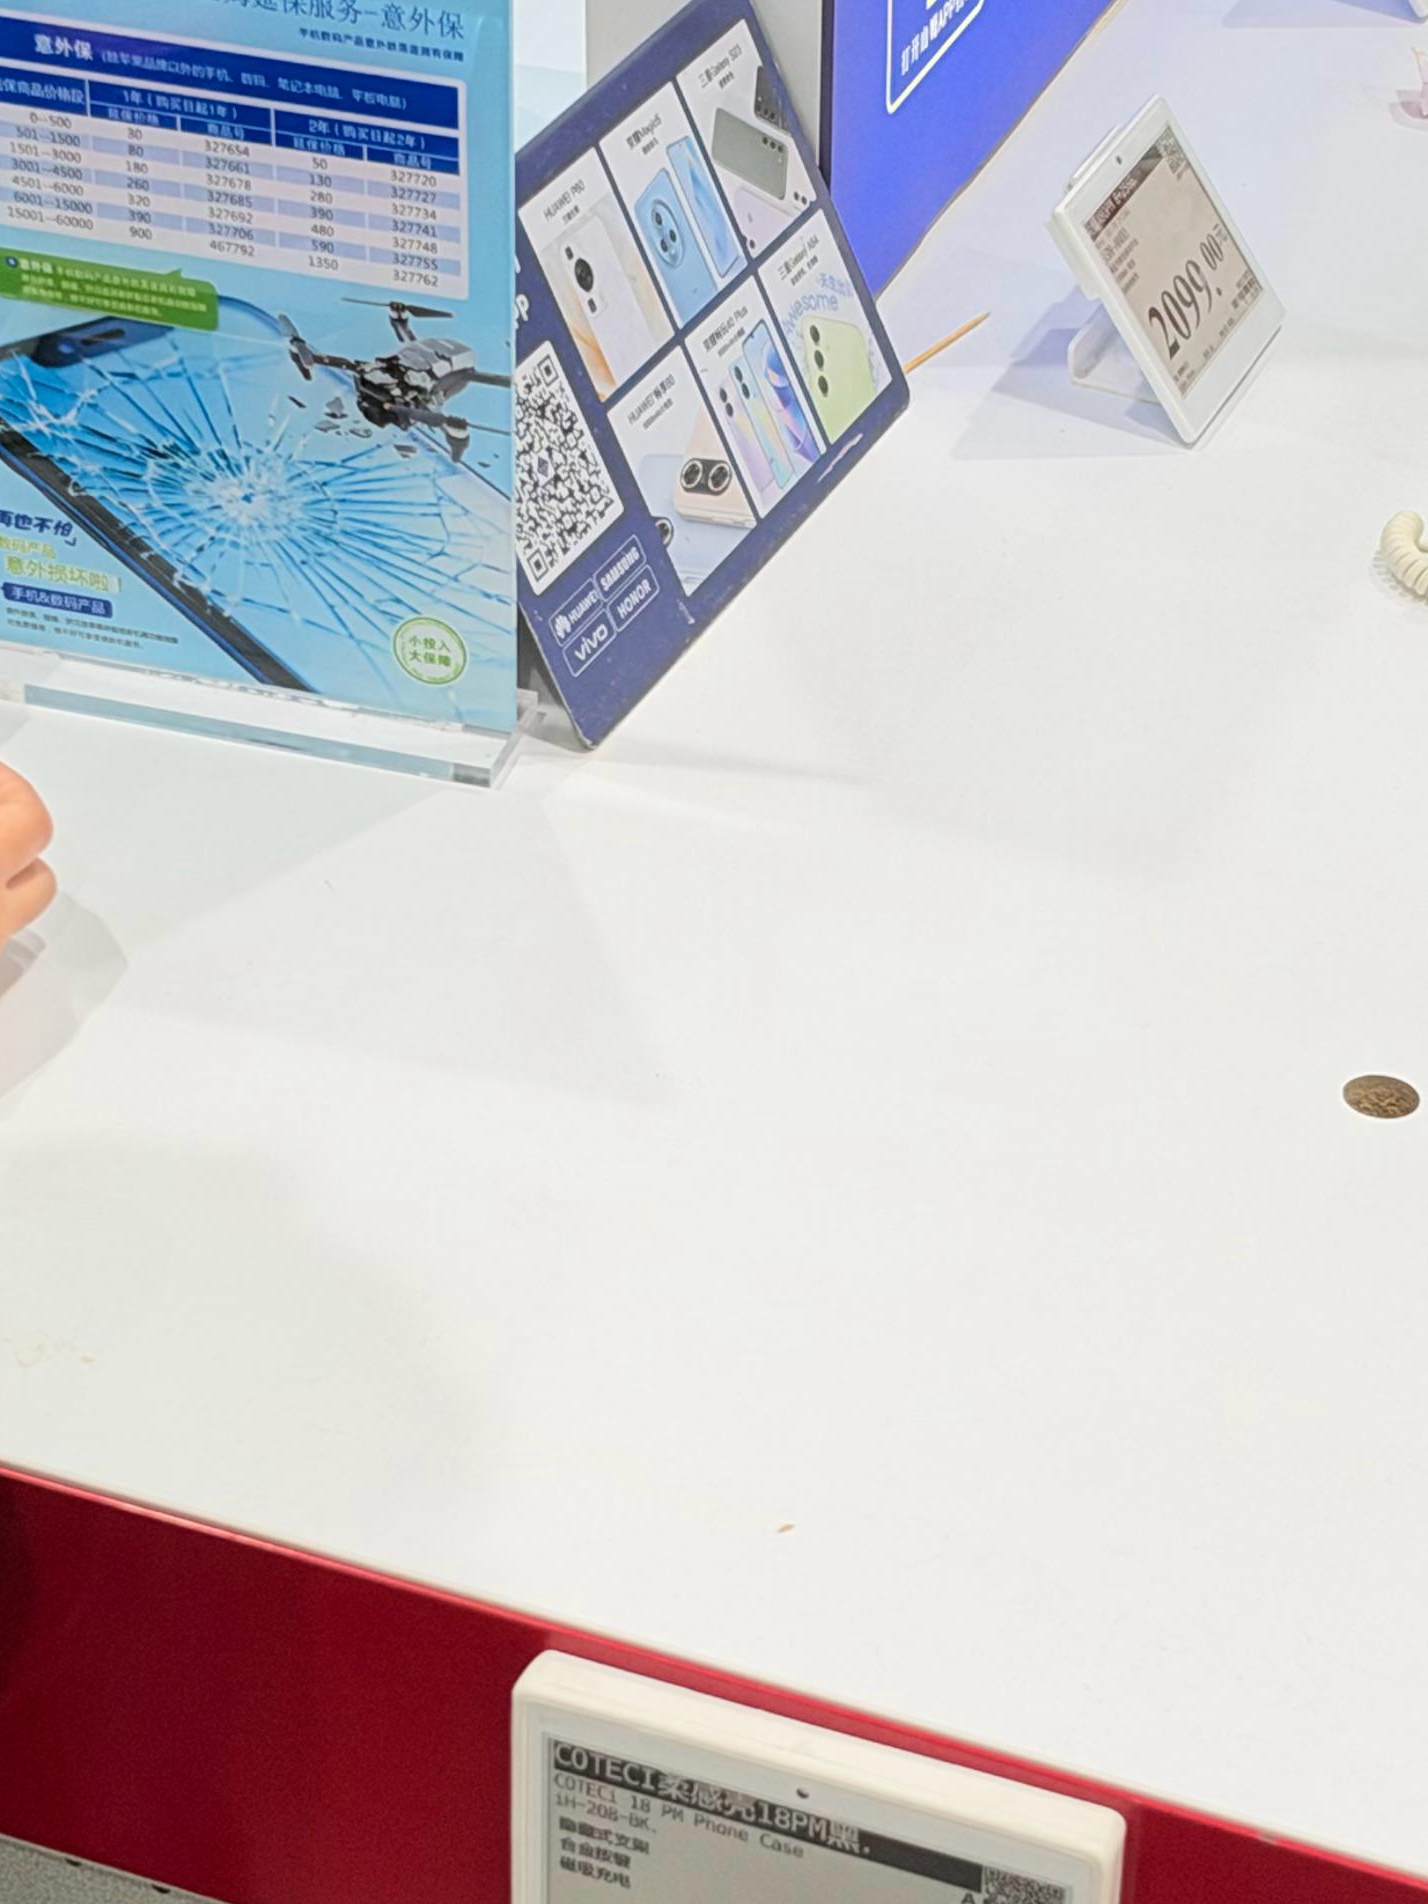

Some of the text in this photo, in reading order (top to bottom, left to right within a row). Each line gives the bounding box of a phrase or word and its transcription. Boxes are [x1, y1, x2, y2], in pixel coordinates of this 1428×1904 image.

[34, 33, 94, 62] 意外保
[127, 127, 143, 141] 30
[204, 139, 251, 159] 327654
[312, 157, 328, 171] 50
[390, 169, 437, 188] 327720
[128, 145, 144, 159] 80
[205, 156, 251, 175] 327661
[309, 173, 332, 188] 130
[390, 186, 437, 205] 327727
[125, 161, 148, 175] 180
[206, 173, 252, 192] 327678
[310, 190, 333, 205] 280
[391, 203, 437, 221] 327734
[126, 177, 150, 192] 260
[207, 190, 253, 209] 327685
[310, 207, 334, 222] 390
[392, 220, 437, 238] 327741
[543, 189, 572, 223] HUAWEI
[127, 194, 151, 208] 320
[208, 206, 254, 225] 327692
[310, 223, 335, 238] 480
[392, 236, 438, 255] 327748
[128, 210, 152, 225] 390
[209, 222, 254, 241] 327706
[311, 240, 335, 255] 590
[392, 253, 439, 271] 327755
[129, 226, 153, 241] 900
[210, 239, 255, 258] 467792
[308, 255, 339, 272] 1350
[392, 269, 439, 288] 327762
[1148, 223, 1230, 360] 2099.00元
[628, 390, 663, 427] HUAWEI
[600, 547, 640, 593] SAMSUNG
[11, 587, 107, 616] 手机&数码产品
[569, 592, 599, 625] HUAWEI
[617, 579, 652, 620] HONOR
[408, 635, 452, 654] 小投入
[408, 649, 451, 668] 大保障
[575, 623, 610, 662] vivo
[630, 1794, 652, 1814] 18
[661, 1803, 685, 1823] PM
[693, 1814, 750, 1843] Phone
[759, 1831, 805, 1859] Case
[559, 1836, 632, 1870] 合金按键
[559, 1856, 632, 1889] 磁吸充电
